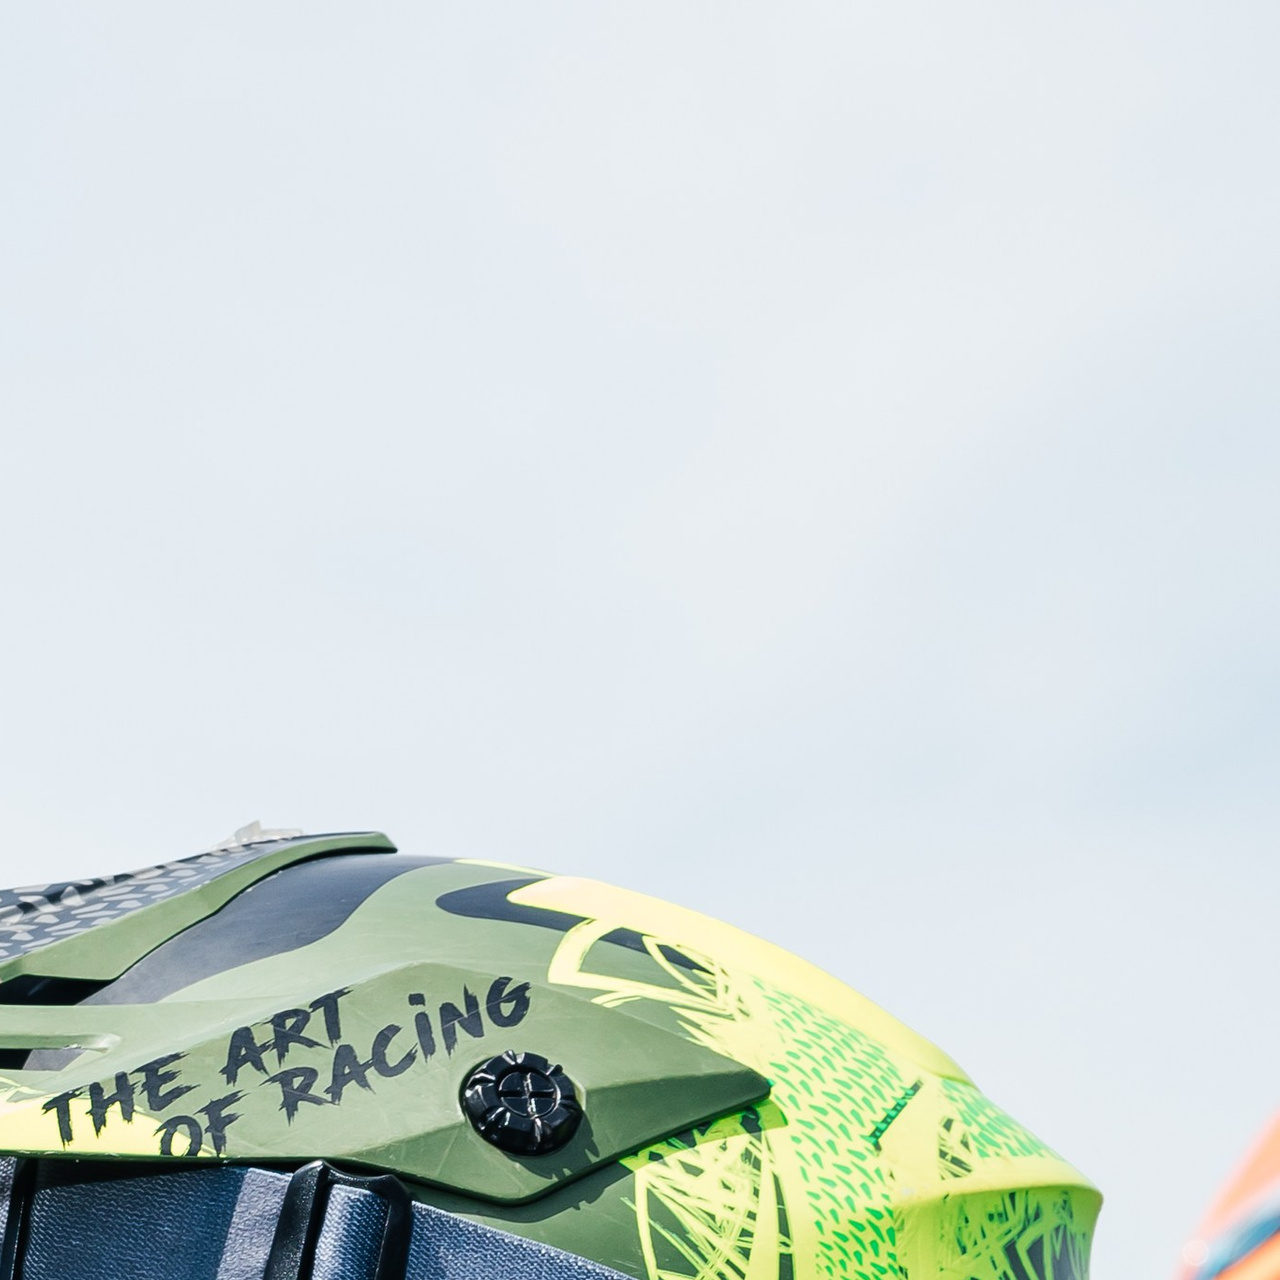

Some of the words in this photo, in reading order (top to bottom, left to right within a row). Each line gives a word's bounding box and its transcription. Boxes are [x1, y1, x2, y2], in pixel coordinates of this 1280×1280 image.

[43, 1051, 190, 1149] THE
[220, 987, 351, 1086] ART
[153, 1087, 249, 1157] OF
